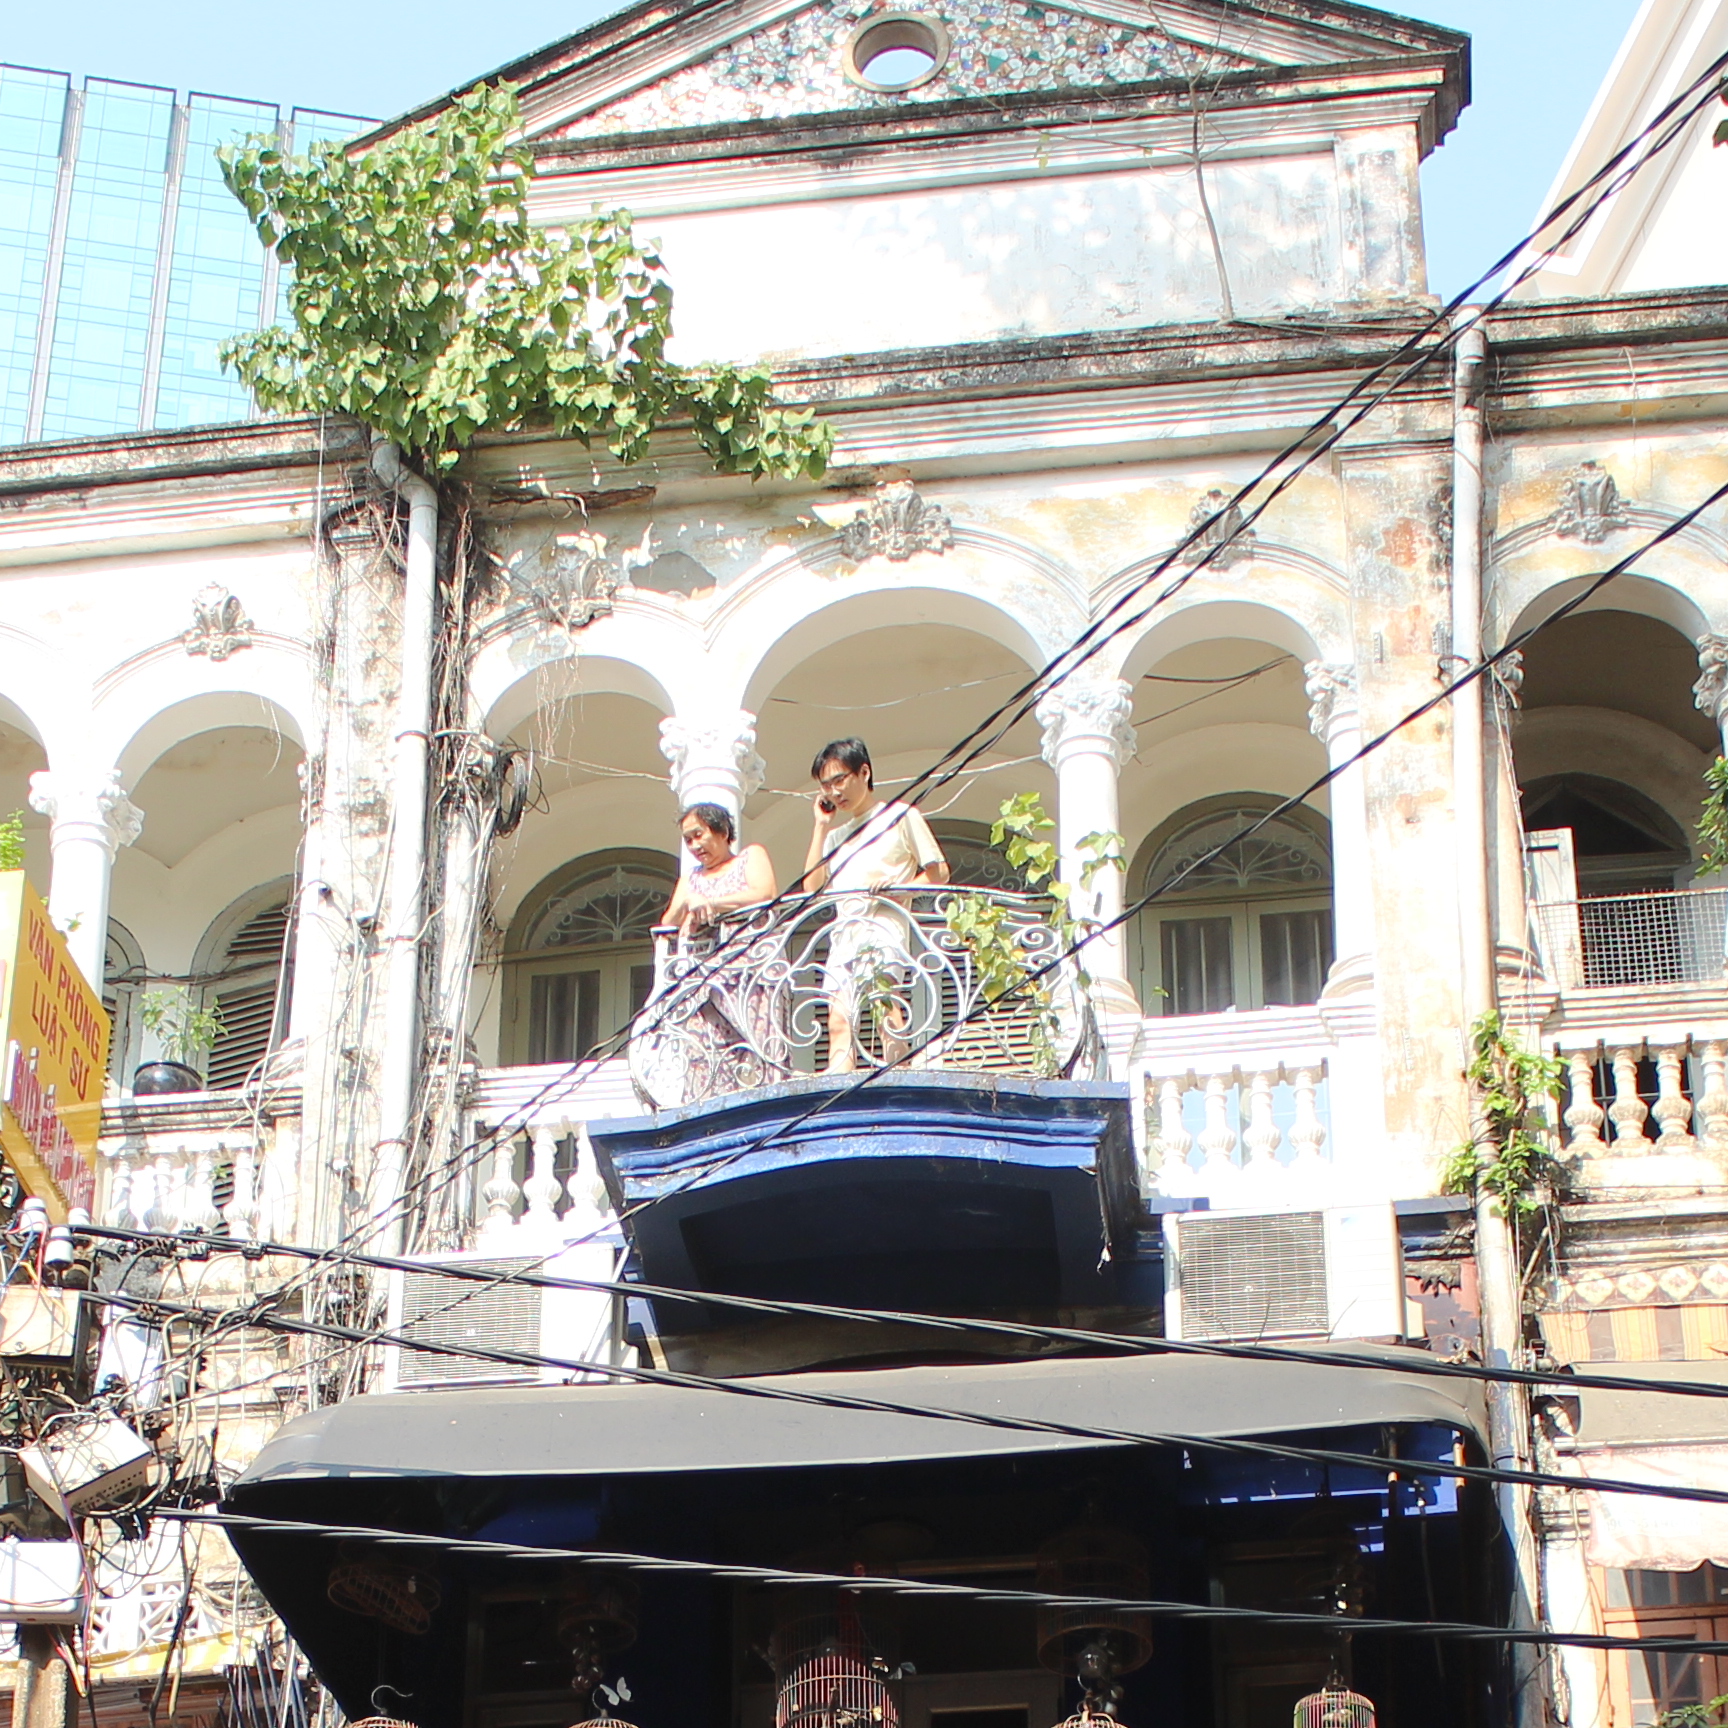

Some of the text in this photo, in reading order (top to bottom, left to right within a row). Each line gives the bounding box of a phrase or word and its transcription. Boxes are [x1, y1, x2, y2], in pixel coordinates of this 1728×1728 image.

[28, 909, 101, 1062] VĂN PHÒNG
[31, 979, 90, 1101] LUẬT SƯ
